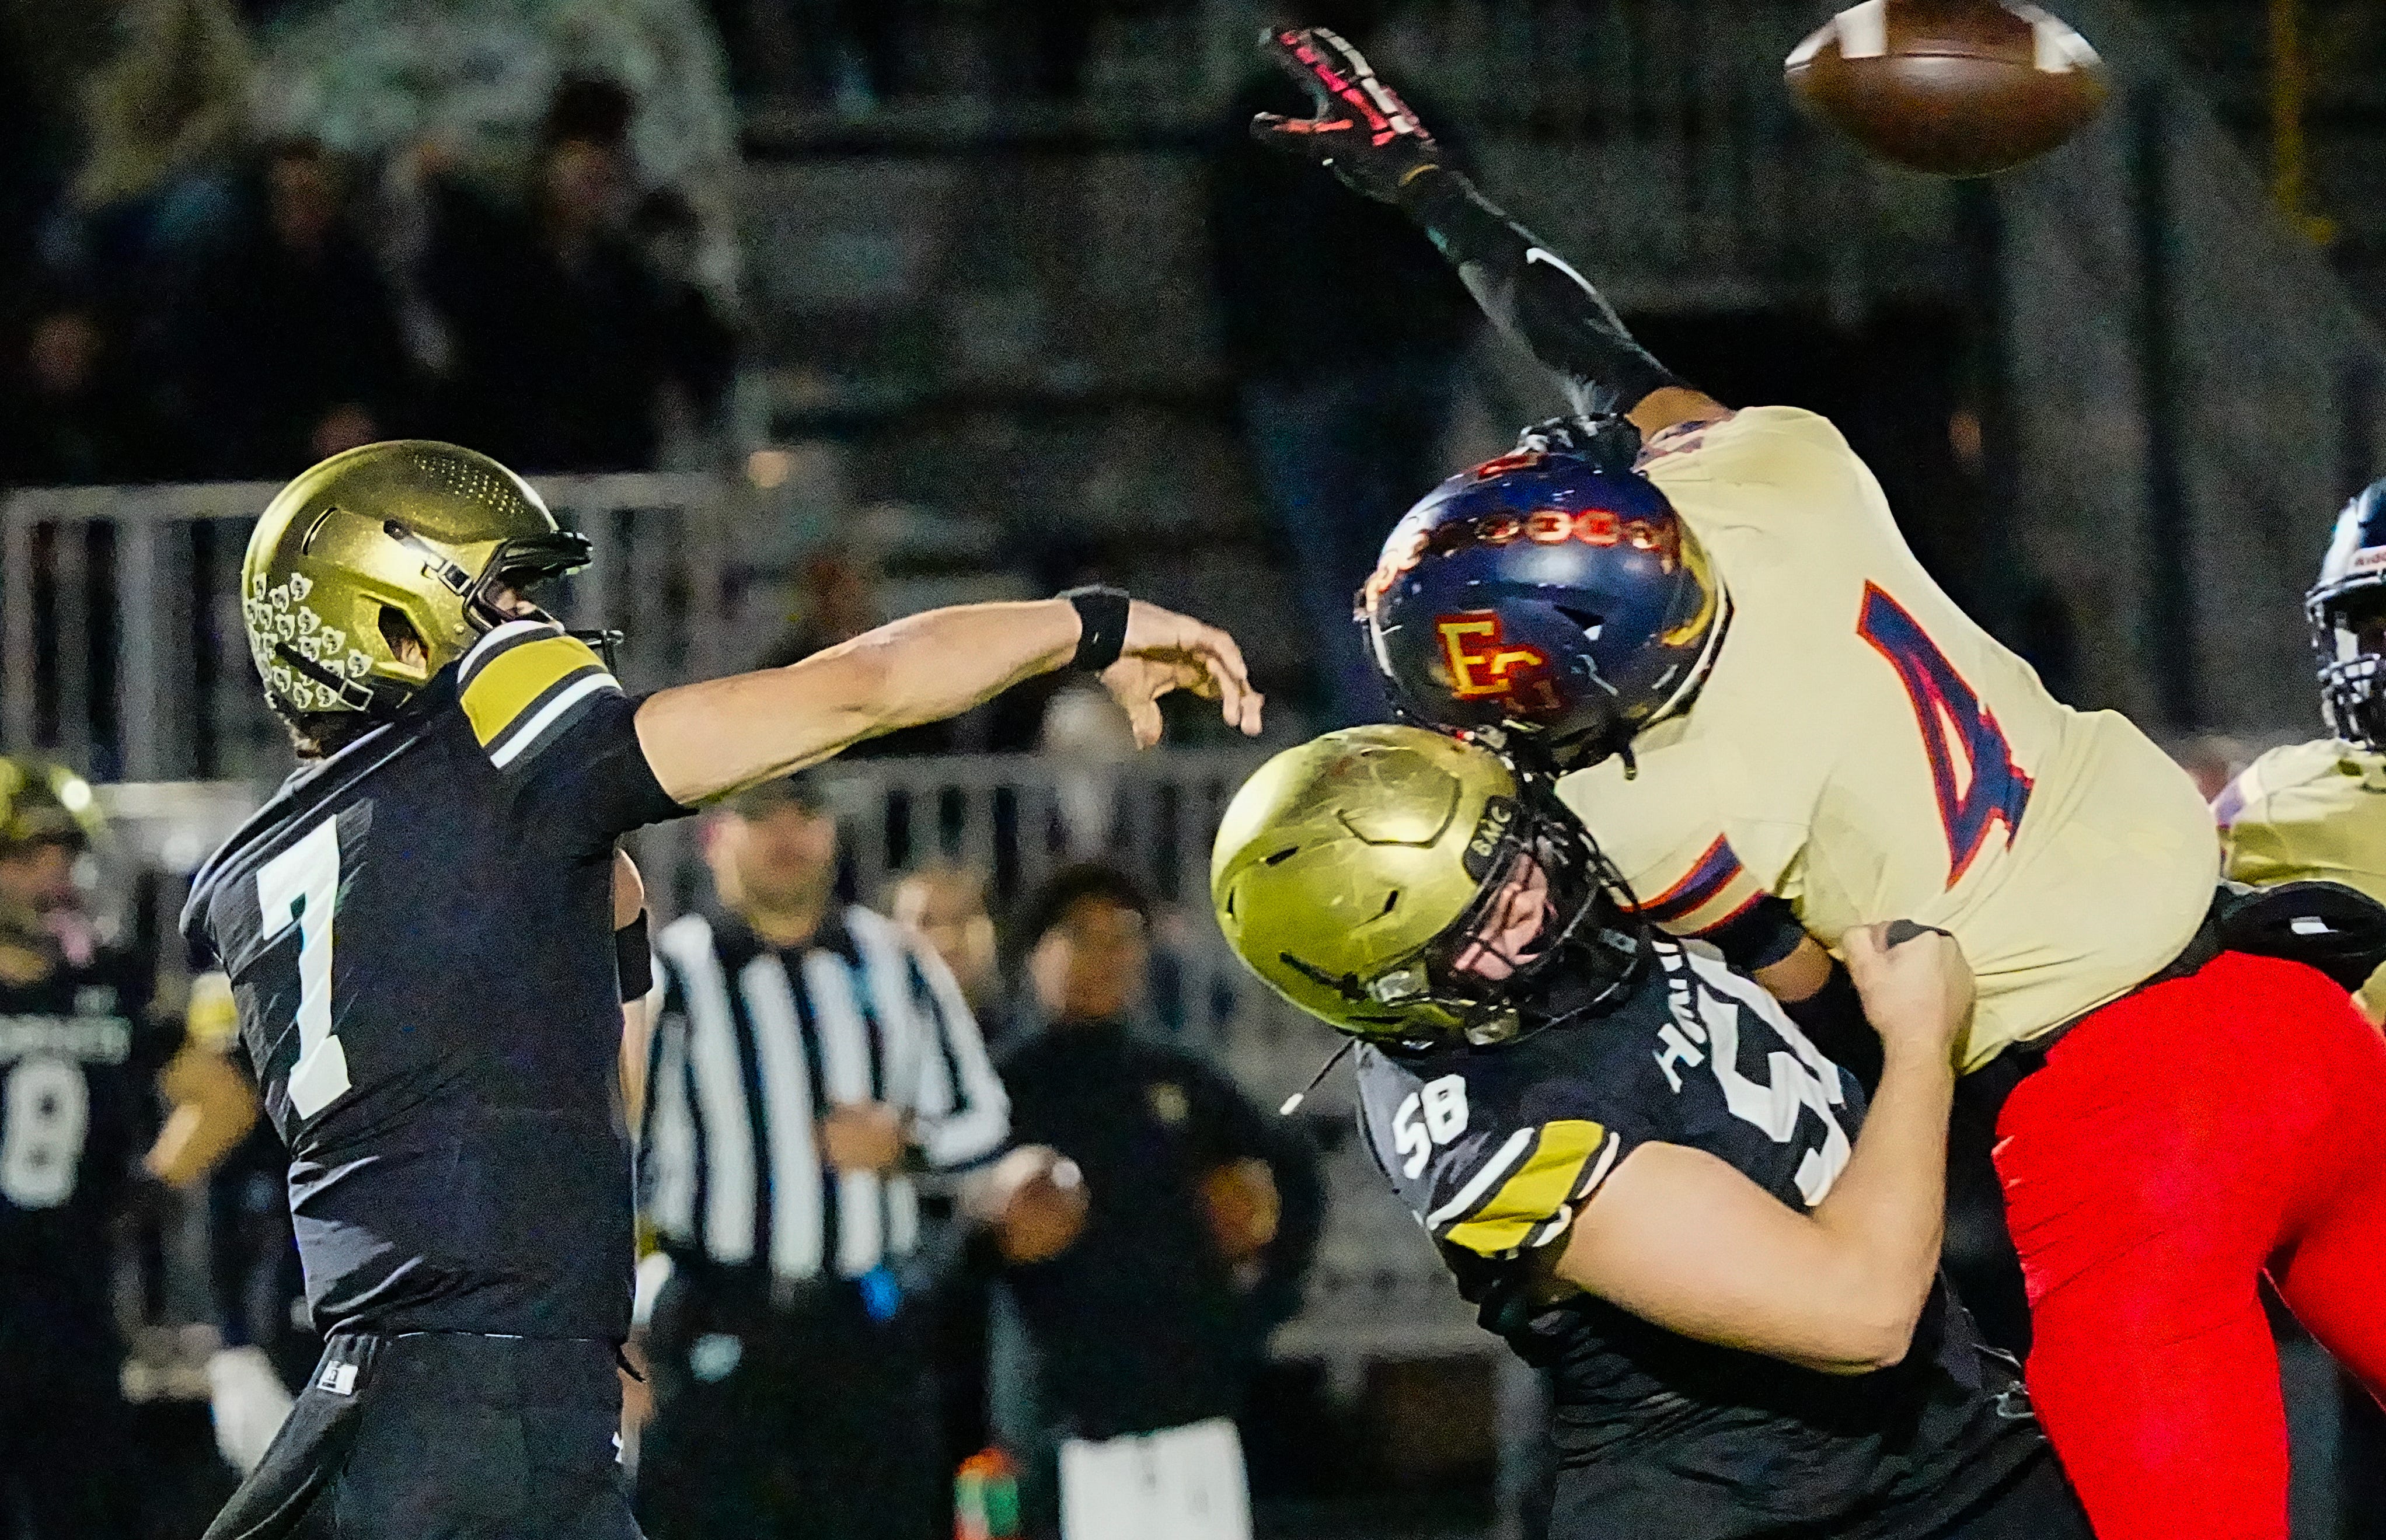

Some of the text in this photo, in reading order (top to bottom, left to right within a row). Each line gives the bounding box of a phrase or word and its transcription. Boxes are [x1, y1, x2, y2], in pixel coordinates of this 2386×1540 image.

[1856, 579, 2035, 893] 4
[1473, 805, 1512, 857] BMC
[256, 813, 353, 1120] 7
[1, 1059, 91, 1210] 8
[1391, 1074, 1470, 1179] 58
